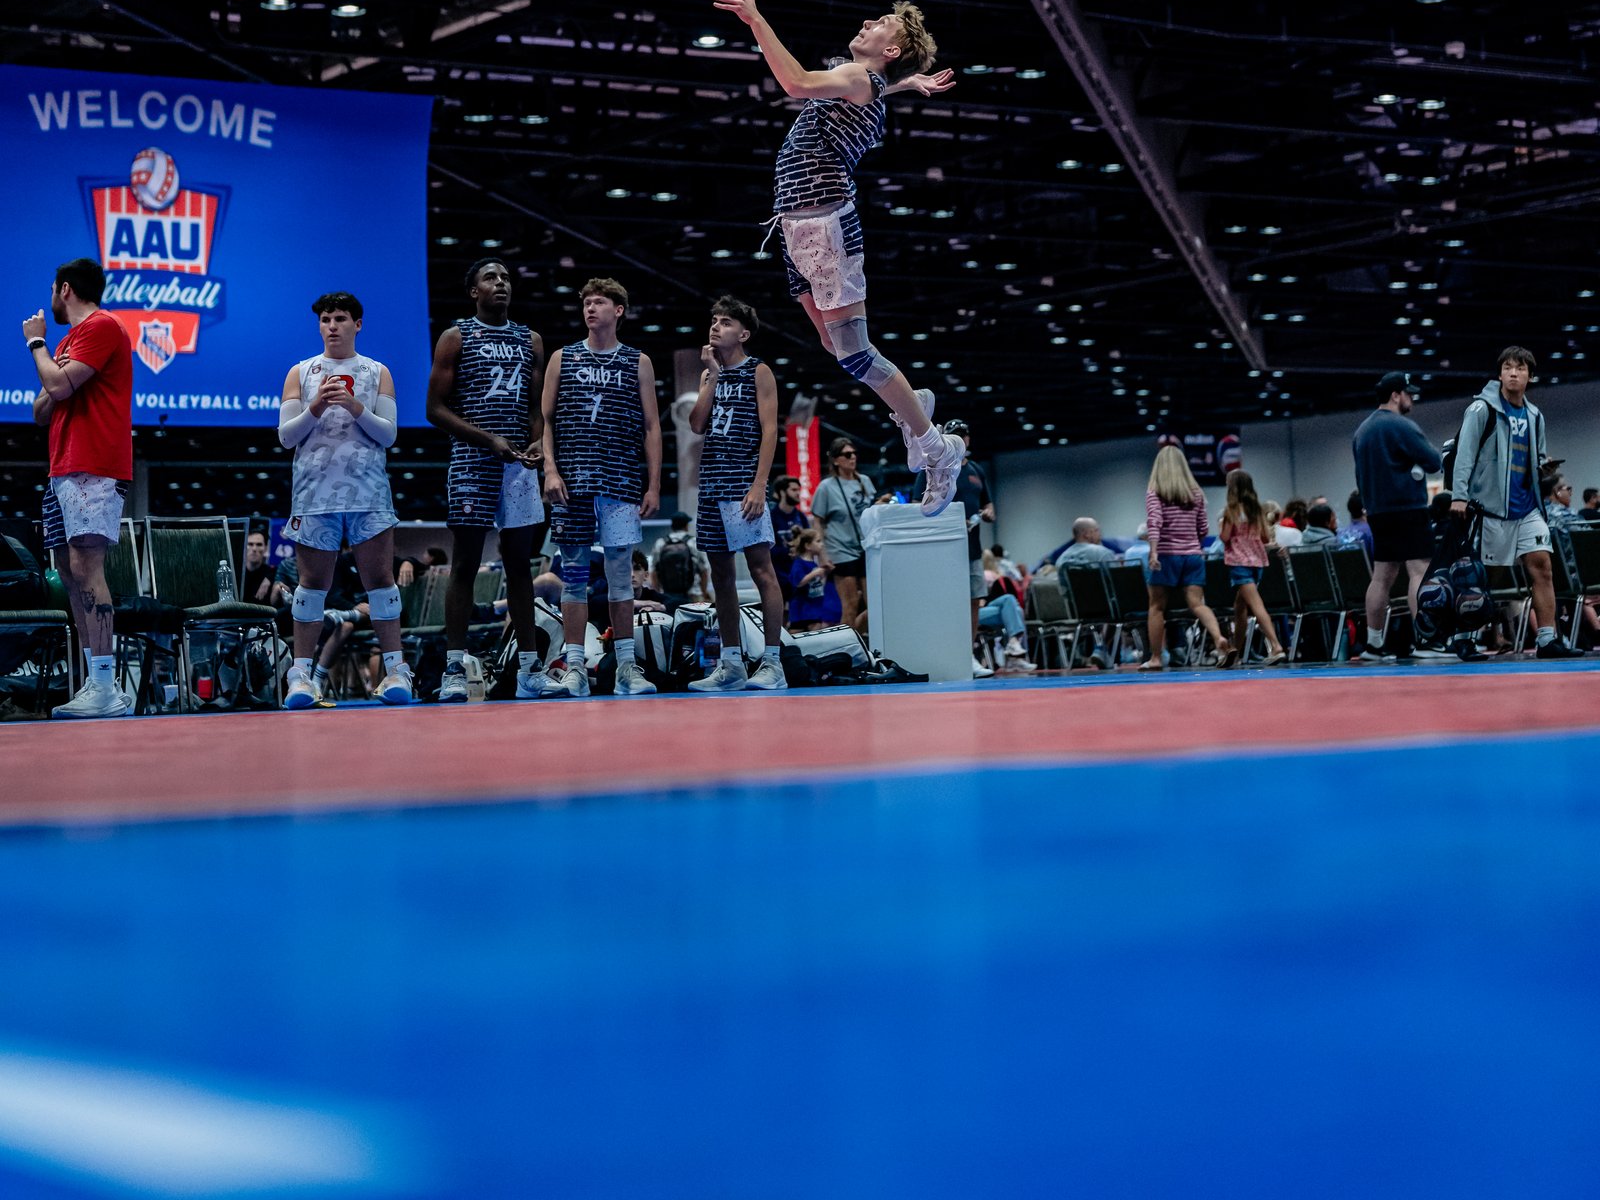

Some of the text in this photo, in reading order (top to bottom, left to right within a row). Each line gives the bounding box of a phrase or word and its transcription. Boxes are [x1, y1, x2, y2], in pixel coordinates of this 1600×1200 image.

[28, 90, 277, 148] WELCOME
[109, 218, 200, 261] AAU
[136, 393, 242, 411] VOLLEYBALL
[484, 362, 523, 402] 24
[710, 403, 734, 436] 21
[796, 426, 811, 512] MEDICAL
